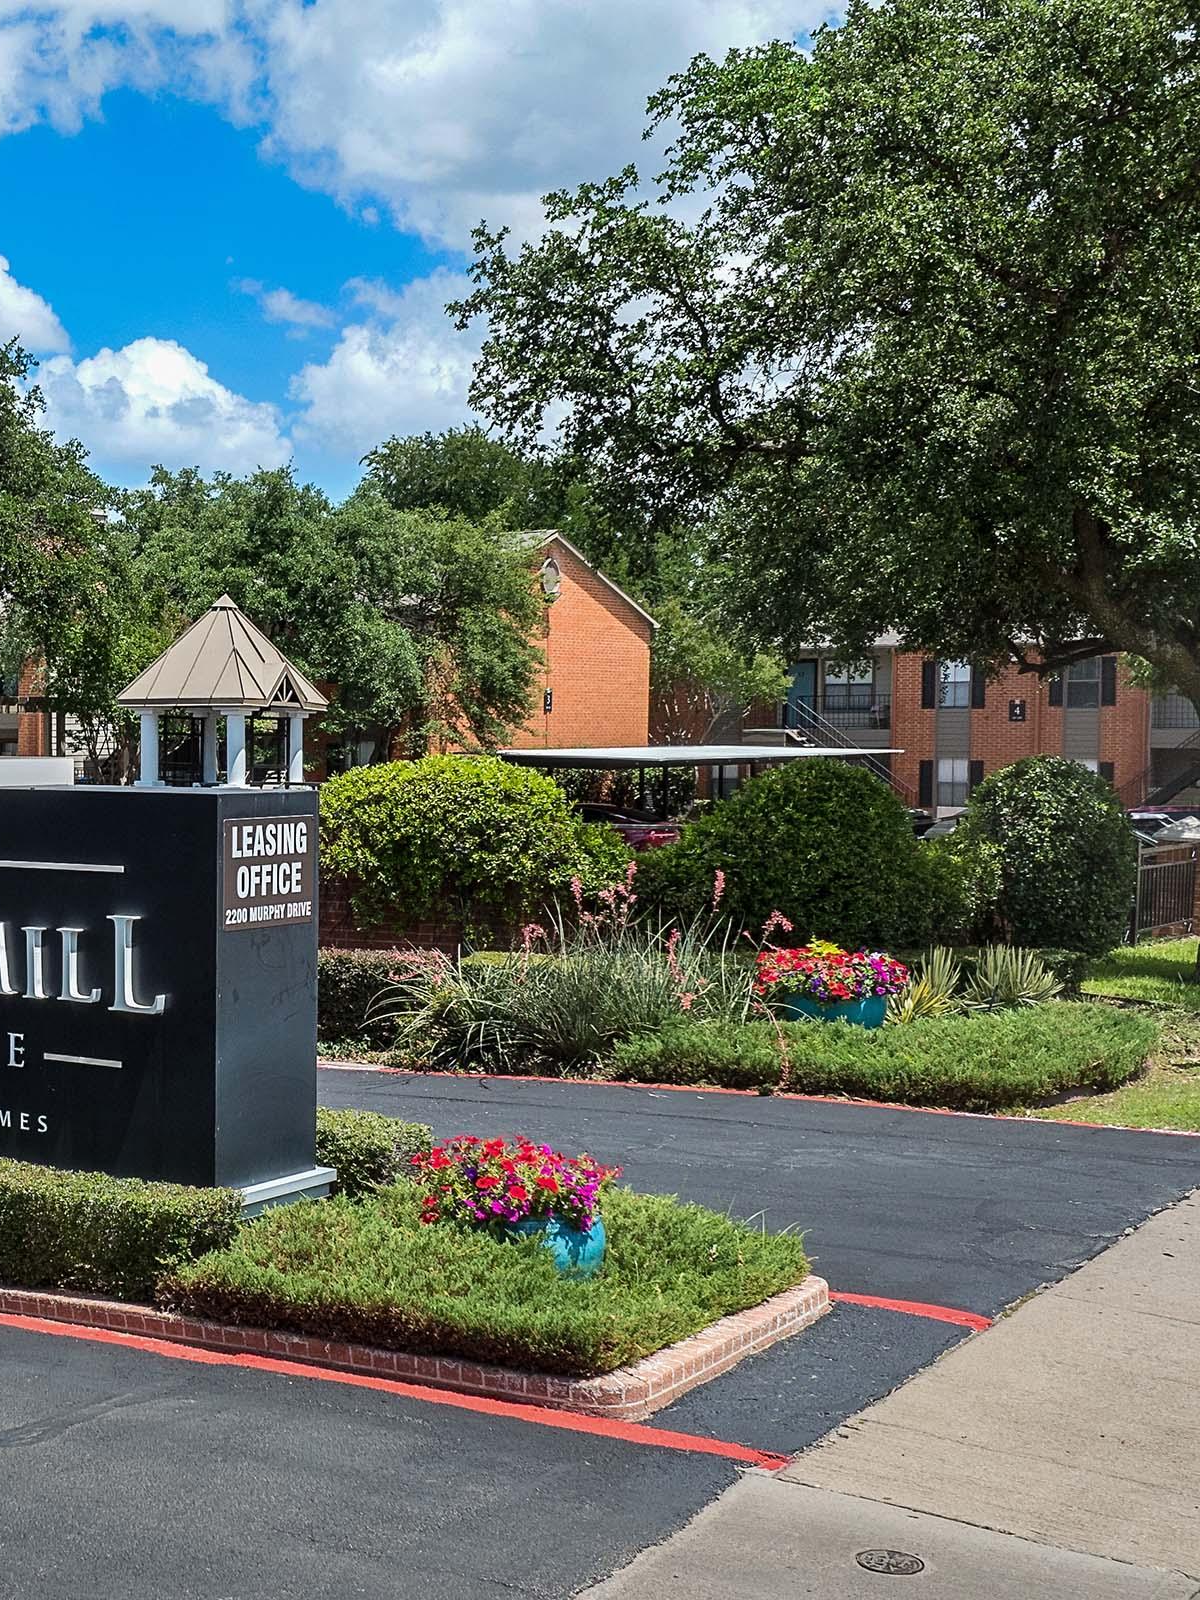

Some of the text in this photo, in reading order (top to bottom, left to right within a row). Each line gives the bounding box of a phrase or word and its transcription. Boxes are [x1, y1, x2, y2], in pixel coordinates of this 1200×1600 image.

[1014, 706, 1020, 715] 4
[232, 822, 308, 858] LEASING
[236, 861, 302, 899] OFFICE
[225, 901, 312, 925] 2200 MURPHY DRIVE
